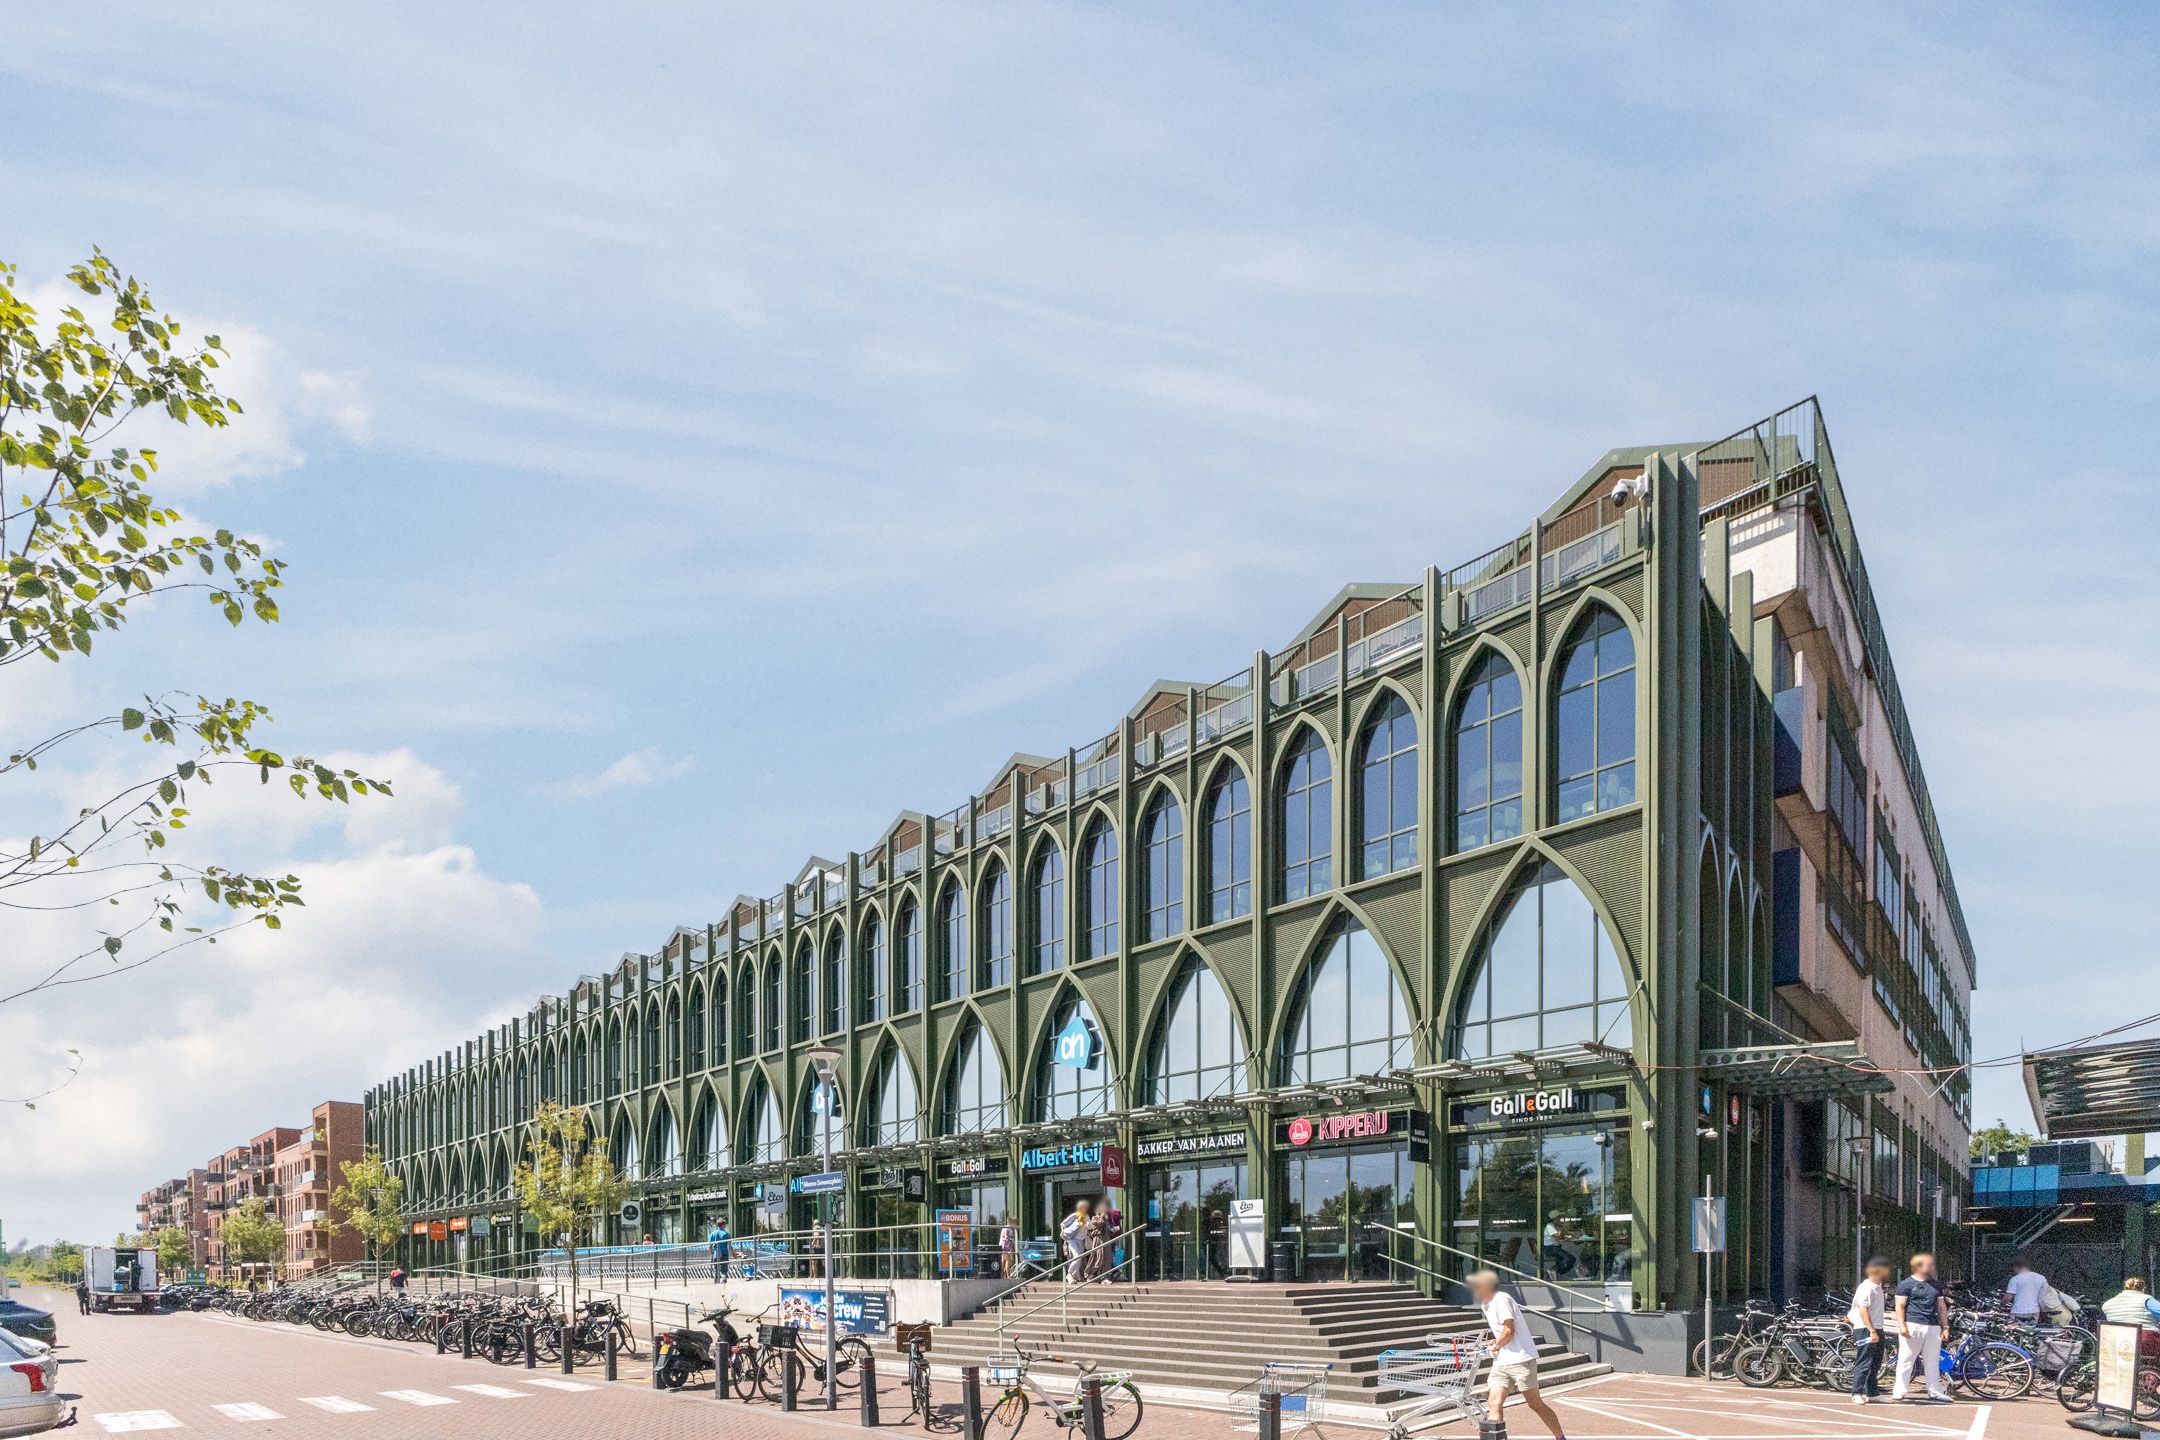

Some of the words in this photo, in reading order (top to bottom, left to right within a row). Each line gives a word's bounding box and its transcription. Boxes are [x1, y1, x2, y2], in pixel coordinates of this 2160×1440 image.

[1319, 1110, 1388, 1141] KIPPERIJ
[1138, 1142, 1173, 1156] BAKKER
[1178, 1138, 1197, 1151] VAN
[1199, 1132, 1245, 1149] MAANEN
[1021, 1147, 1068, 1169] Albert
[1072, 1142, 1103, 1165] Heij
[767, 1191, 784, 1202] Etos
[1240, 1201, 1254, 1212] Etos
[945, 1214, 968, 1222] BONUS
